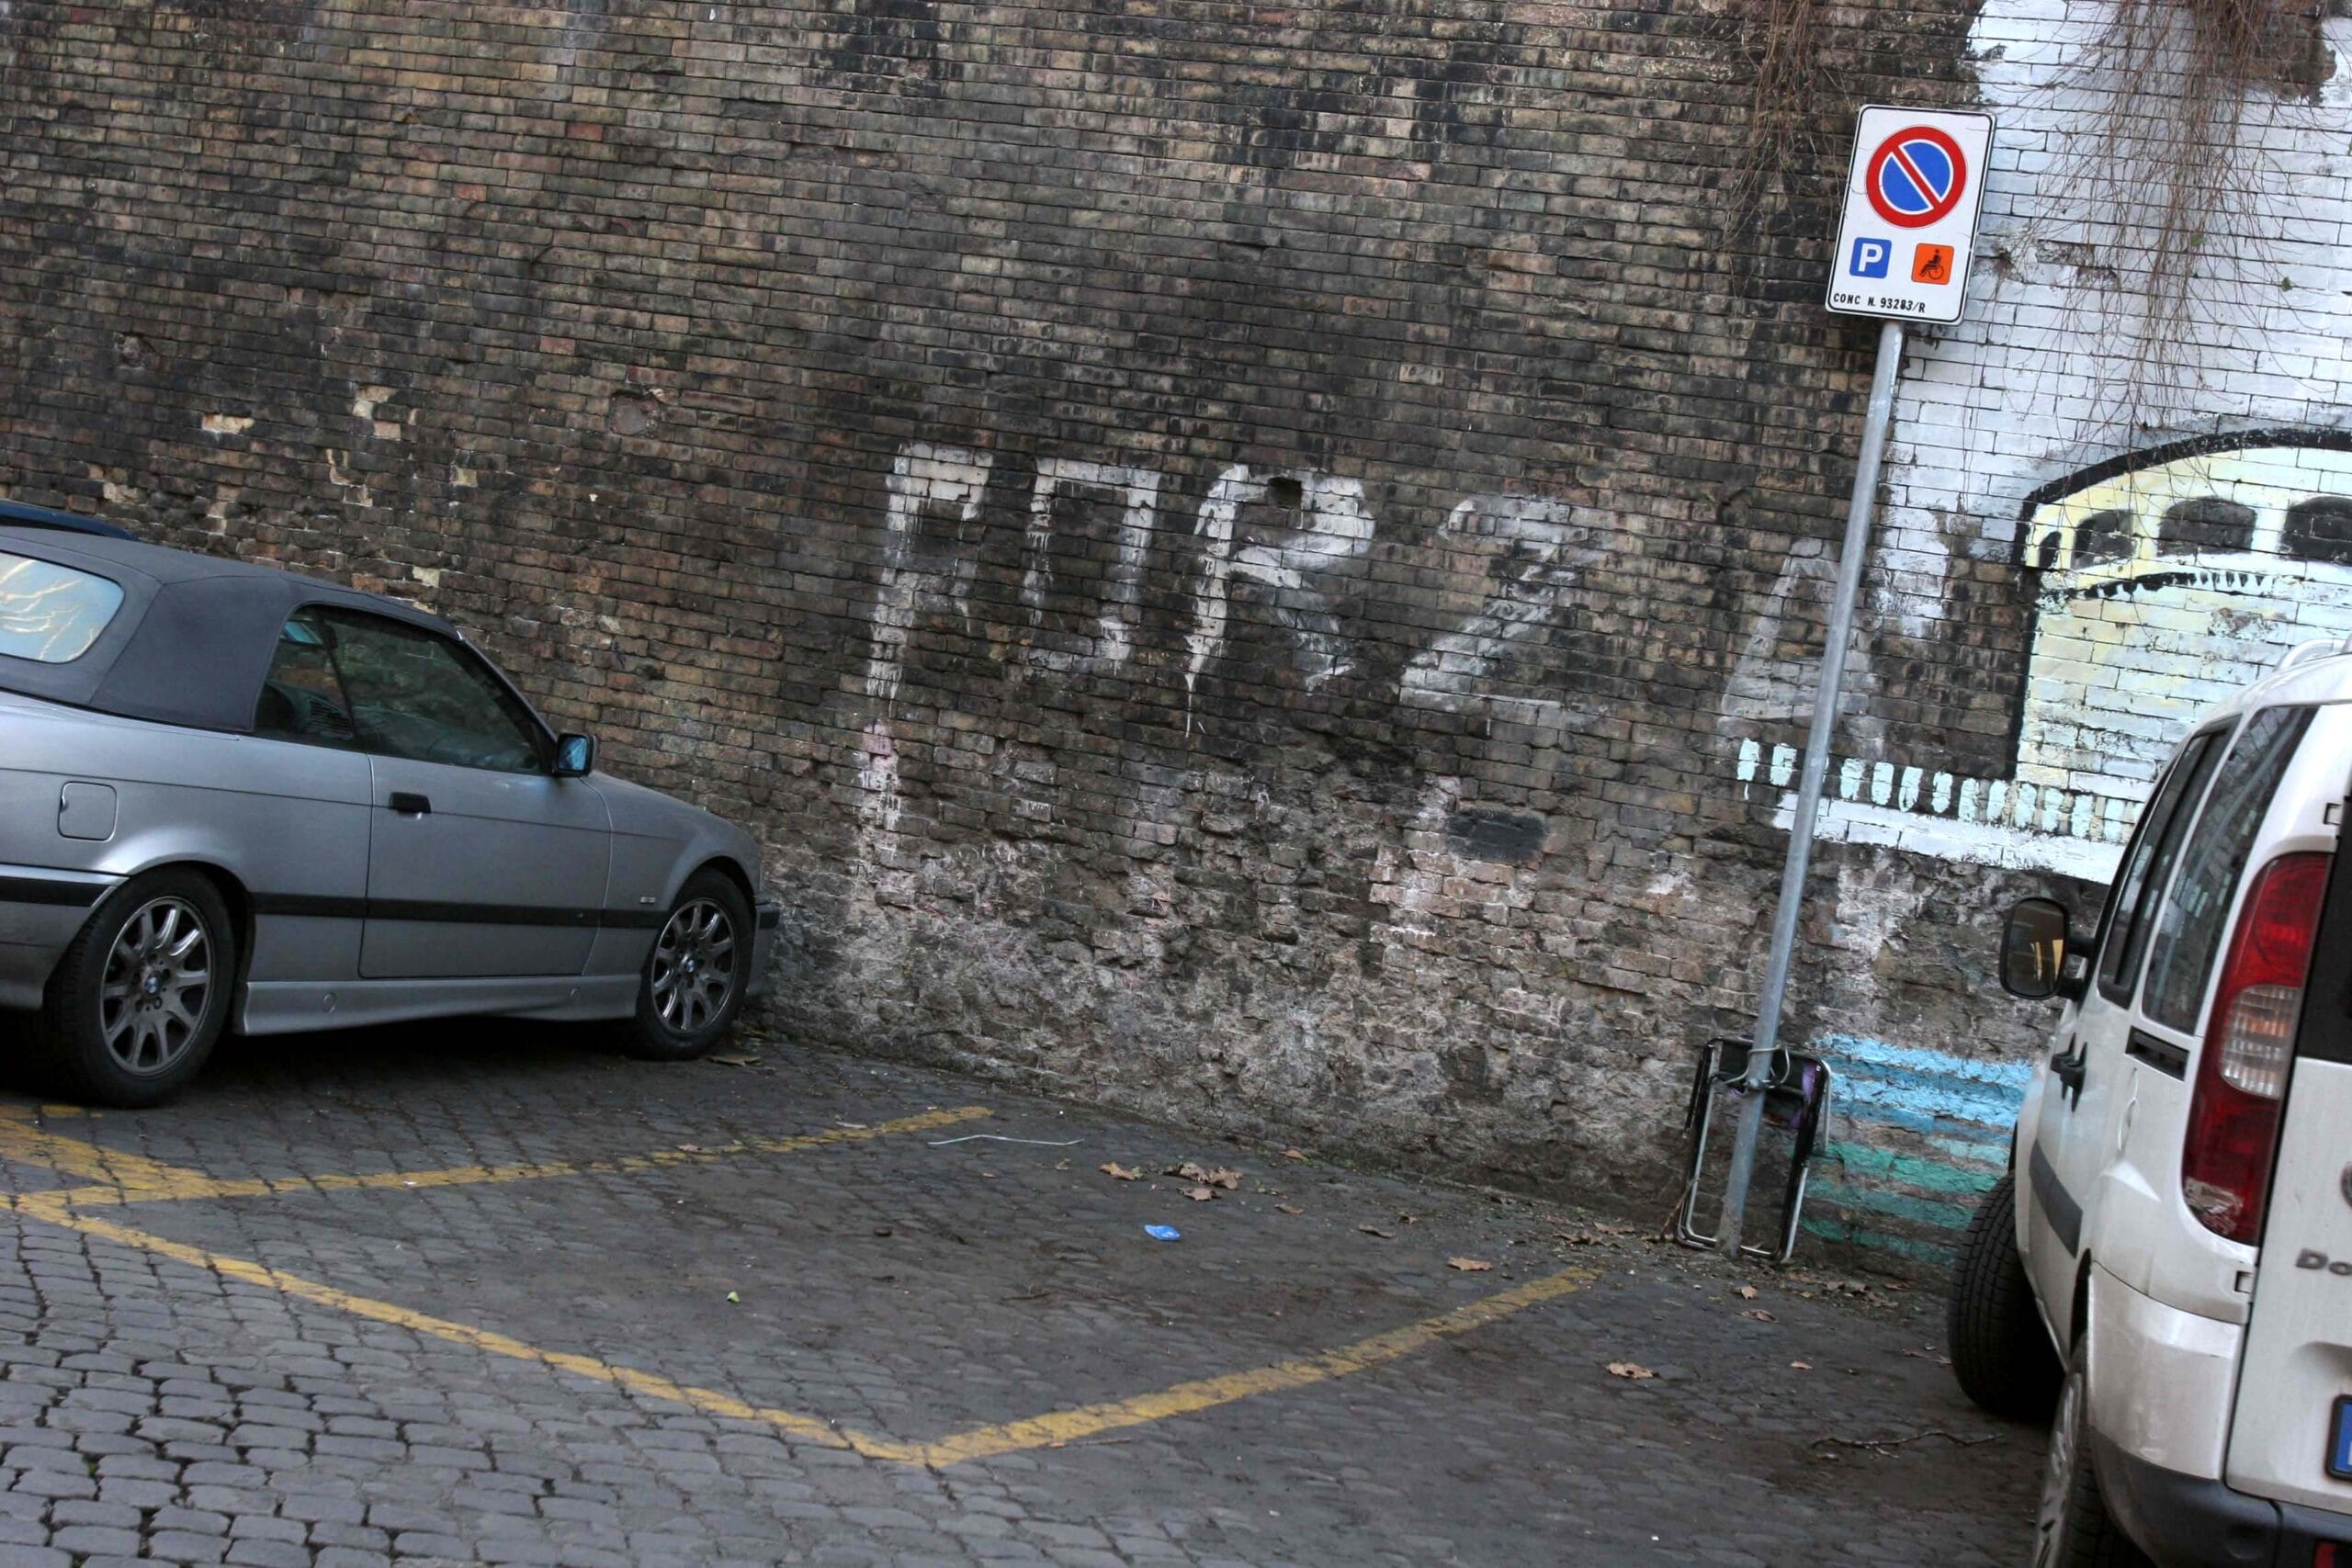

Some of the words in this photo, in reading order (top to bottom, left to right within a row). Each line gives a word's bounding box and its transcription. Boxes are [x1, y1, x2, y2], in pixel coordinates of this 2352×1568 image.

[1858, 243, 1883, 273] P
[1833, 292, 1861, 305] CONC
[1880, 297, 1926, 313] 93283/R
